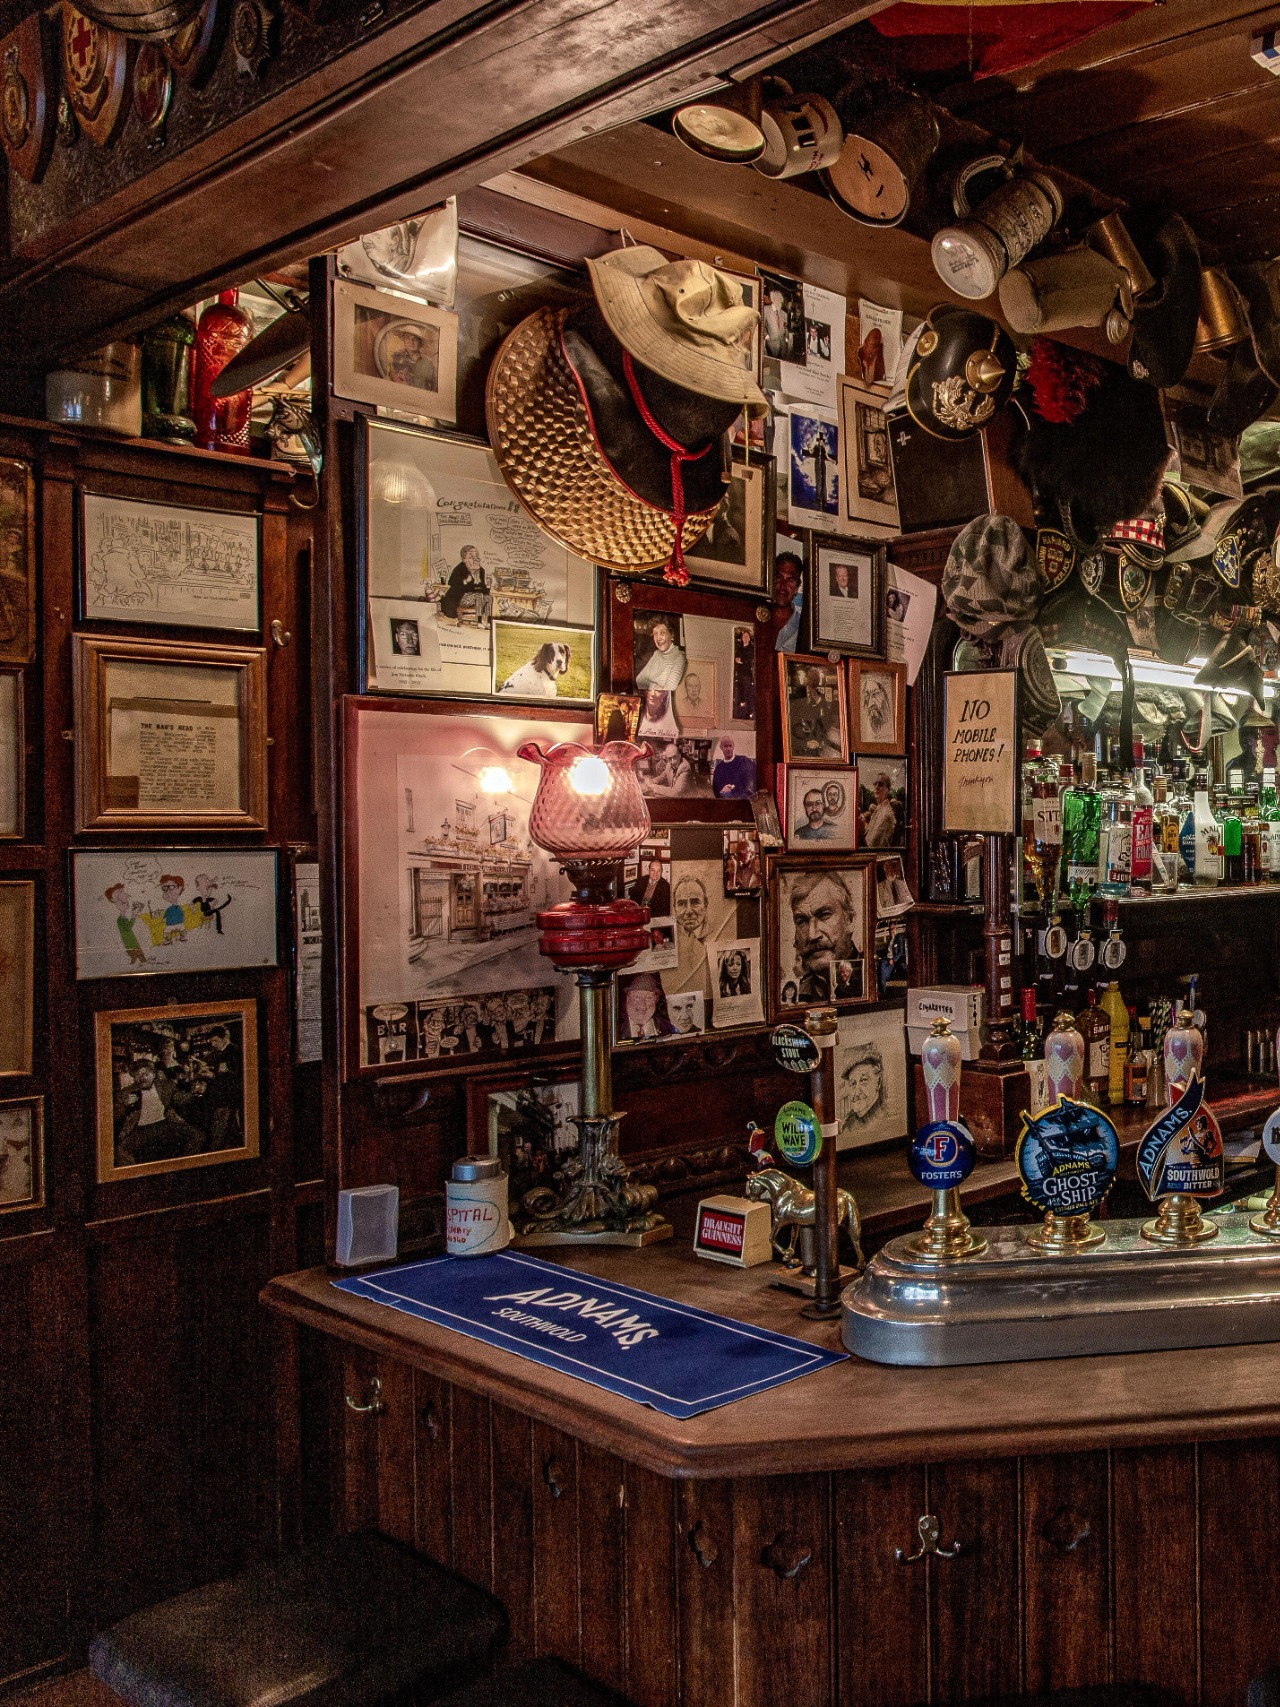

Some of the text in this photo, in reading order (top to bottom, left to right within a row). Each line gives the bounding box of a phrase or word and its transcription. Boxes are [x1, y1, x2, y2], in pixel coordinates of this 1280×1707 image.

[959, 699, 991, 722] NO
[952, 727, 997, 744] MOBILE
[953, 744, 1005, 763] PHONES!
[781, 1048, 801, 1058] STOUT
[782, 1122, 805, 1134] WILD
[782, 1134, 806, 1146] WAVE
[933, 1136, 950, 1162] F
[921, 1170, 963, 1180] FOSTER'S
[1052, 1161, 1091, 1177] ADNAMS
[1166, 1167, 1220, 1182] SOUTHWOLD
[1042, 1171, 1099, 1196] GHOST
[1183, 1180, 1213, 1190] BITTER
[1061, 1186, 1097, 1206] SHIP
[703, 1217, 744, 1234] DRAUGHT
[701, 1228, 742, 1246] GUINNESS
[491, 1307, 588, 1342] SOUTHWOLD
